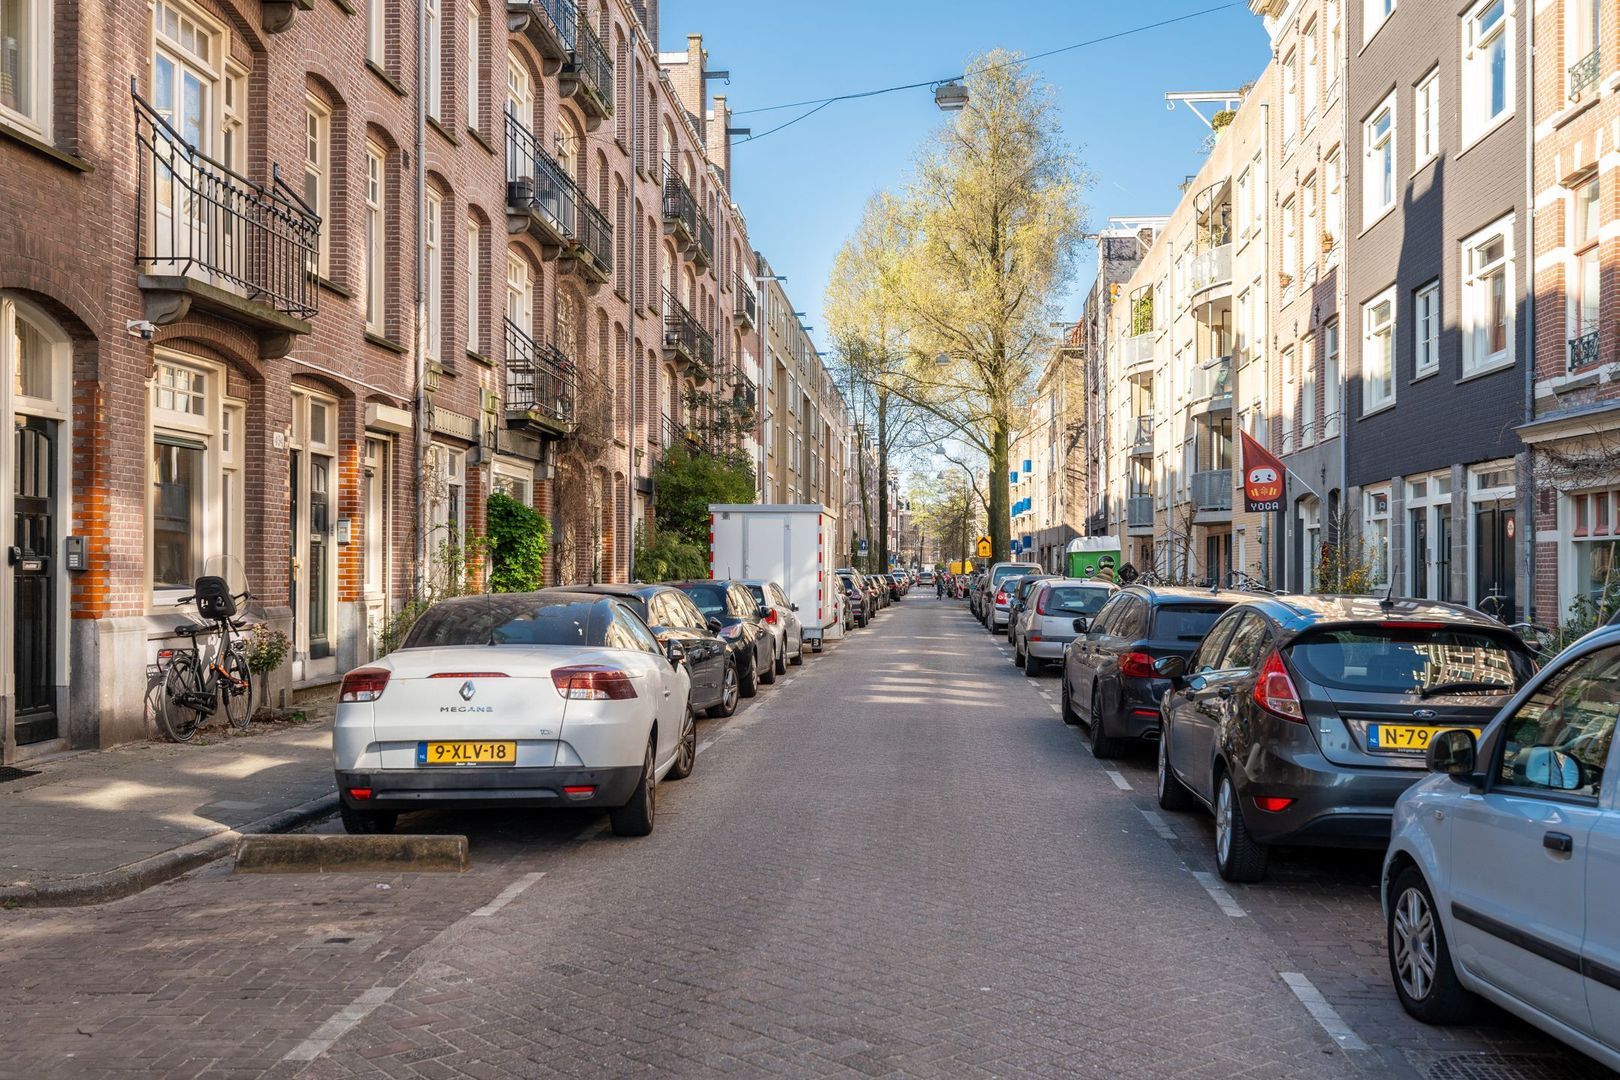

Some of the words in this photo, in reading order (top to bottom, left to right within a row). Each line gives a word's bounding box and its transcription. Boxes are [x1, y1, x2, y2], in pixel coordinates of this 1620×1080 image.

[1250, 502, 1279, 511] YOGA
[1385, 728, 1437, 745] N-79
[435, 744, 507, 759] 9-XLV-18
